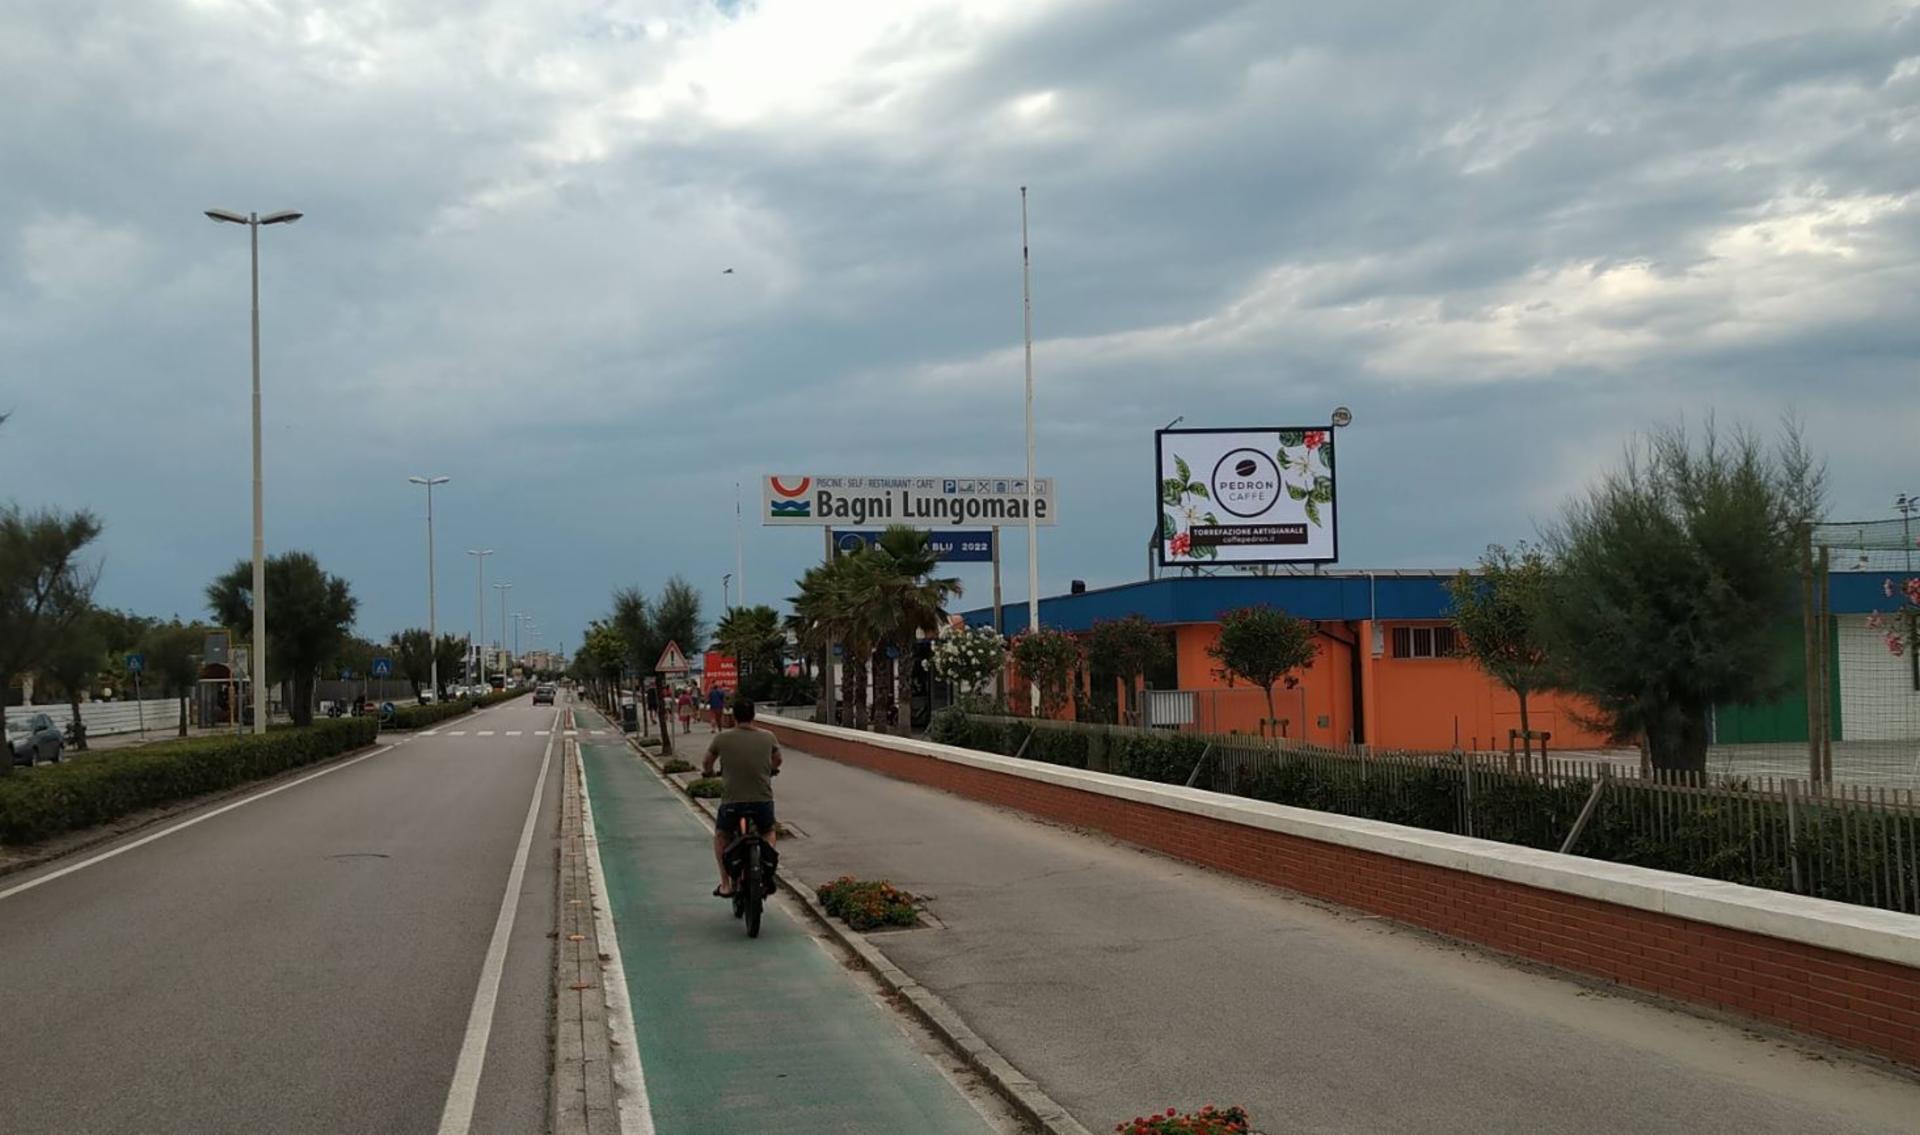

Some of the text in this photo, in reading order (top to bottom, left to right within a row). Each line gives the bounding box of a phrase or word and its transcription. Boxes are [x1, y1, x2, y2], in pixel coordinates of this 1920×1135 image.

[816, 478, 842, 488] PISCINE
[847, 478, 863, 488] SELF
[868, 478, 911, 489] RESTAURANT
[945, 480, 954, 492] P
[1220, 481, 1273, 490] PEDRON
[817, 490, 1047, 524] Bagni Lungomare
[1193, 526, 1304, 536] TORREFAZIONE ARTIGIANALE
[932, 542, 953, 551] BLU
[961, 542, 988, 551] 2022
